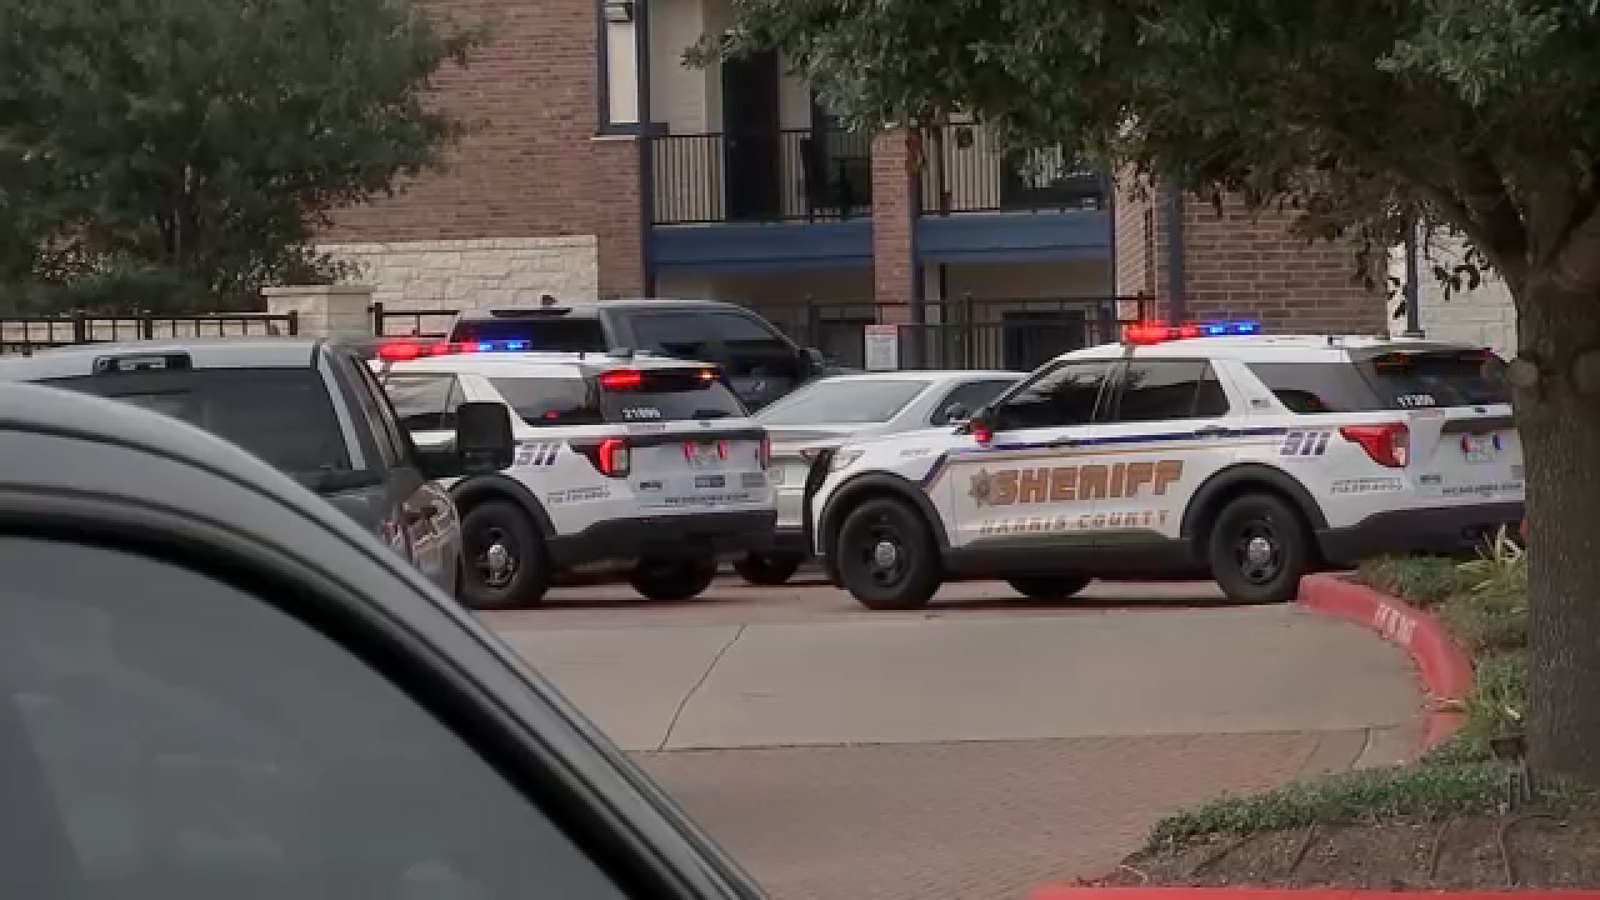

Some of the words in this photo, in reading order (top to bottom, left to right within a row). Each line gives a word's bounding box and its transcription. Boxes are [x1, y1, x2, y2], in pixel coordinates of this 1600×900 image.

[1280, 431, 1330, 456] 911
[990, 459, 1184, 504] SHERIFF
[979, 516, 1065, 535] HARRIS
[1079, 509, 1170, 528] COUNTY
